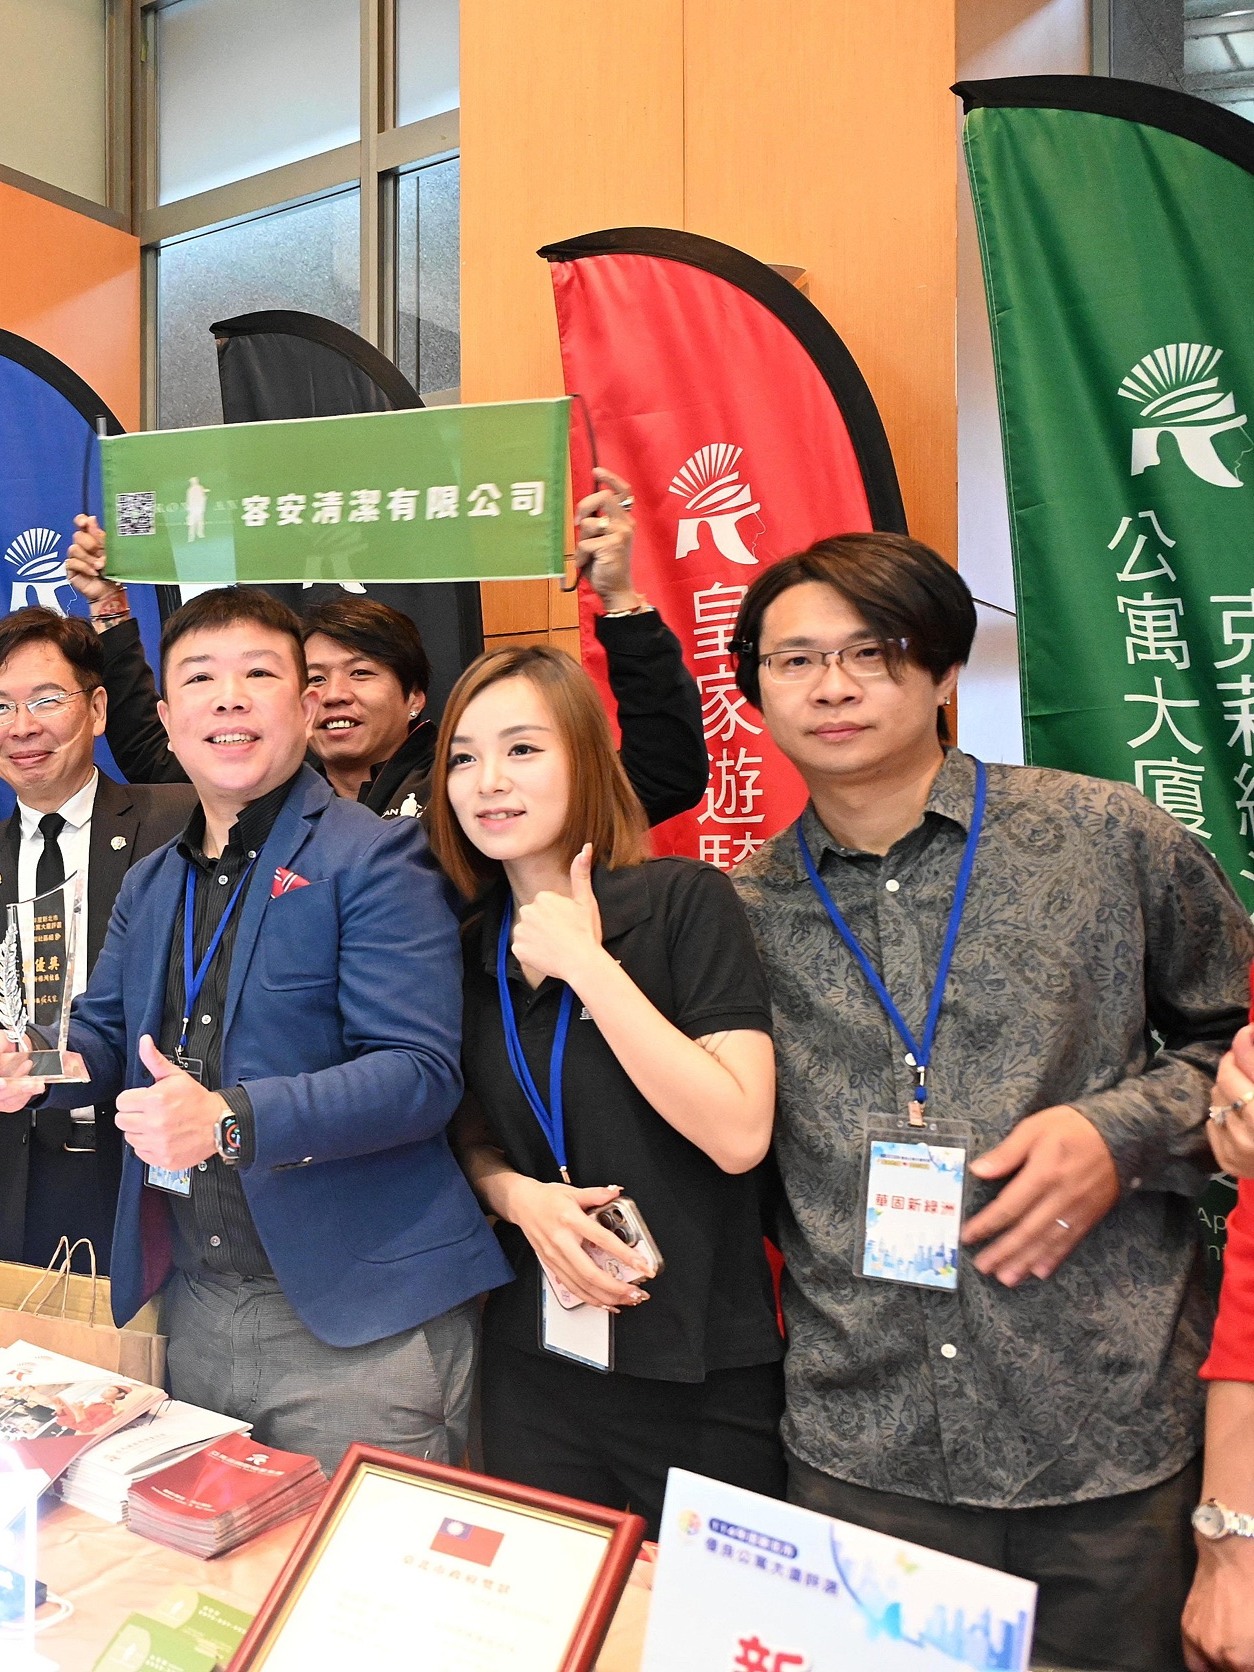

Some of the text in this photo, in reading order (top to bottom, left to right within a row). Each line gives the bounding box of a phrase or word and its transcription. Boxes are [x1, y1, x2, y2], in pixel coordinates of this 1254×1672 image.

[240, 481, 545, 528] 容安清潔有限公司
[876, 1194, 955, 1216] 華固新綠洲
